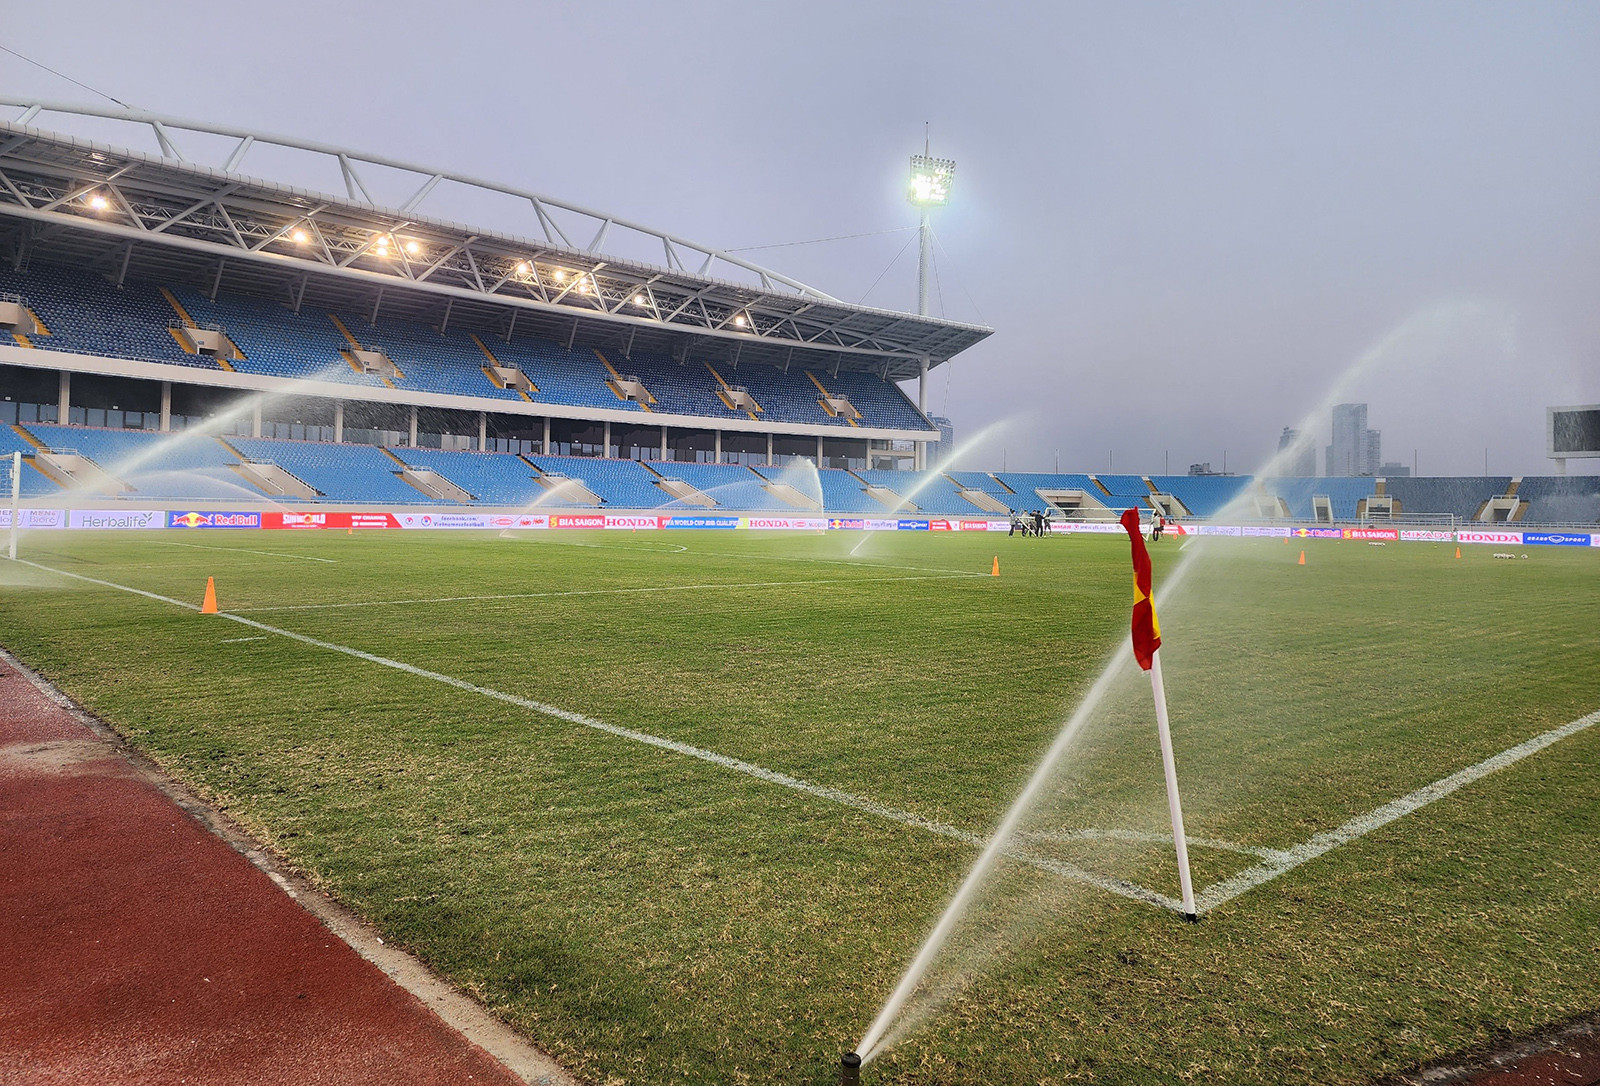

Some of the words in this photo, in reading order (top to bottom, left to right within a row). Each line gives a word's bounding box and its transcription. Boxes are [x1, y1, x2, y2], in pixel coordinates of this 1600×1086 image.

[82, 515, 147, 527] Herbalife
[214, 514, 235, 525] Red
[237, 514, 258, 525] Bull
[559, 518, 575, 526] BIA
[607, 518, 656, 527] HONDA
[750, 518, 789, 528] HONDA
[1401, 531, 1453, 539] MIKADO
[1459, 533, 1521, 543] HONDA
